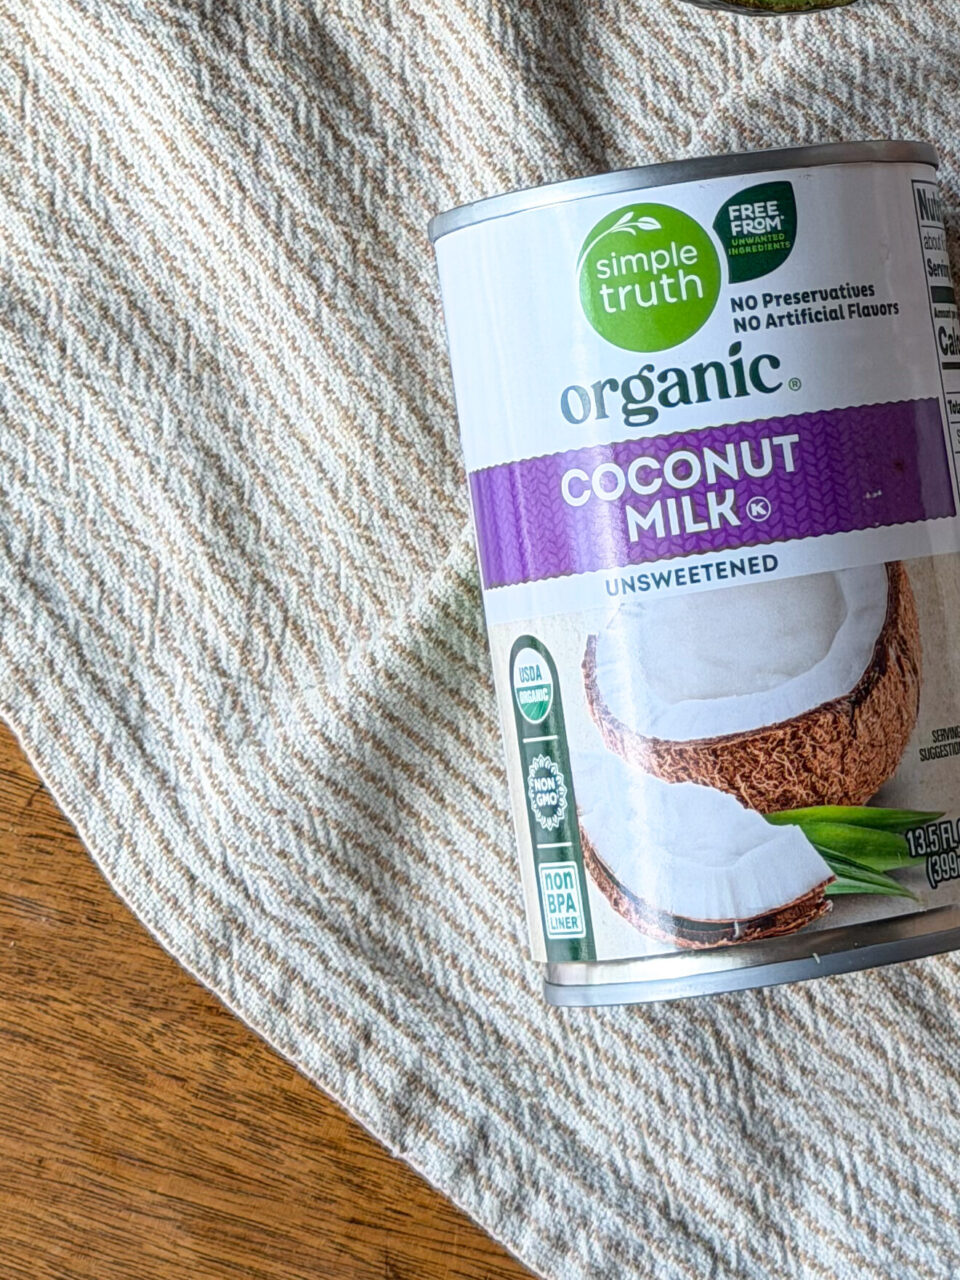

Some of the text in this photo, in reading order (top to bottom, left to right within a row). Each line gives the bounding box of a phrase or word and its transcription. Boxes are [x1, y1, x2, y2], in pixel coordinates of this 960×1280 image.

[728, 200, 780, 221] FREE
[731, 217, 783, 237] FROM
[728, 241, 791, 256] INGREDIENTS
[731, 232, 786, 247] UNWANTED
[596, 241, 698, 279] simple
[600, 269, 704, 314] truth
[730, 282, 875, 313] NO Preservatives
[733, 301, 900, 333] NO Artificial Flavors
[560, 340, 784, 427] organic
[561, 434, 800, 507] COCONUT
[625, 488, 742, 543] MILK
[605, 554, 779, 597] UNSWEETENED
[518, 663, 543, 683] USDA
[518, 687, 549, 705] ORGANIC
[534, 776, 557, 791] NON
[536, 791, 558, 808] GMO
[906, 825, 939, 858] 13.5
[940, 821, 958, 850] FL
[544, 870, 574, 891] non
[547, 891, 578, 915] BPA
[549, 915, 580, 931] LINER
